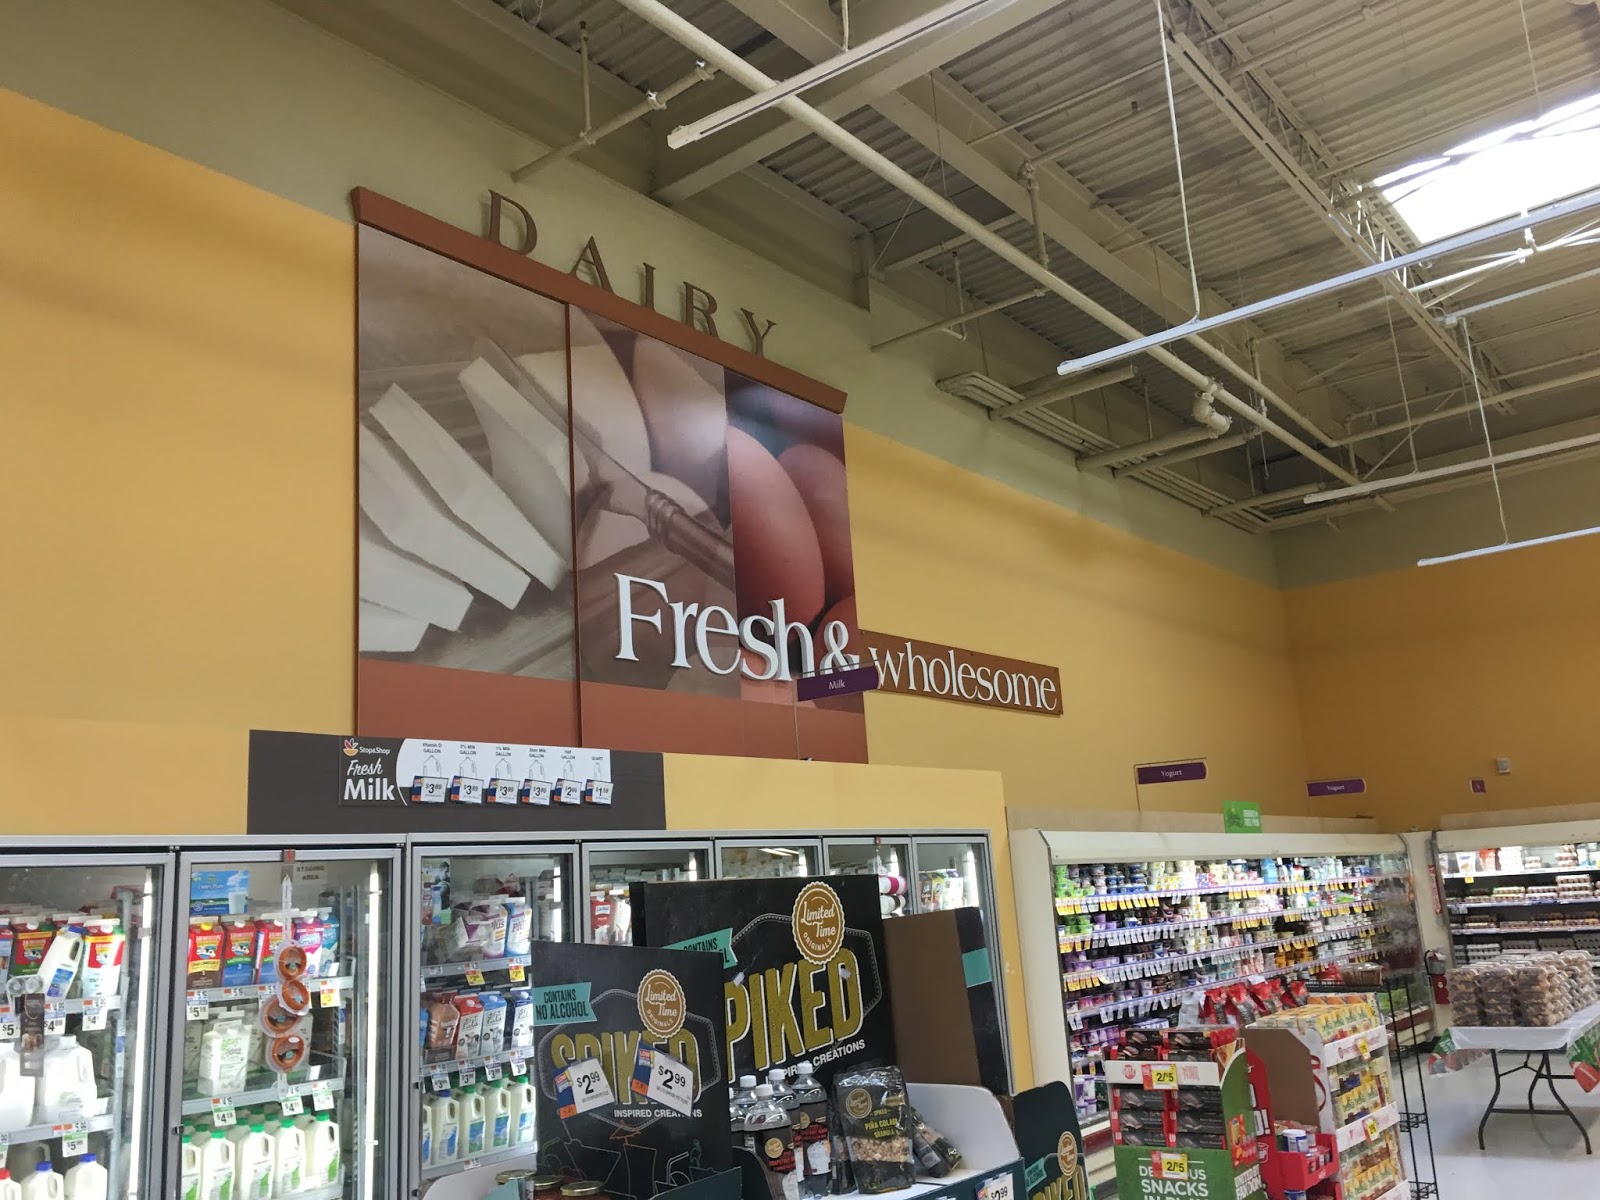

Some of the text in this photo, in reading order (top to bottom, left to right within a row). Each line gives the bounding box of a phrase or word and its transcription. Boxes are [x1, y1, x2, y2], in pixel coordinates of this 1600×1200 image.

[488, 189, 777, 358] DAIRY
[614, 572, 815, 683] Fresh
[868, 642, 1058, 711] wholesome
[828, 680, 846, 690] Milk
[346, 757, 384, 776] Fresh
[1160, 769, 1183, 778] Yogurt
[343, 777, 396, 801] Milk
[800, 901, 836, 925] Limited
[812, 919, 837, 938] Time
[803, 932, 833, 951] ORIGINALS
[543, 988, 577, 1004] CONTAINS
[645, 984, 678, 1004] Limited
[535, 1005, 547, 1020] NO
[549, 1001, 589, 1018] ALCOHOL
[655, 1002, 678, 1017] Time
[724, 948, 864, 1084] PIKED
[812, 1039, 866, 1067] CREATIONS
[614, 1109, 703, 1118] INSPIRED CREANS
[1141, 1179, 1209, 1197] SNACKS
